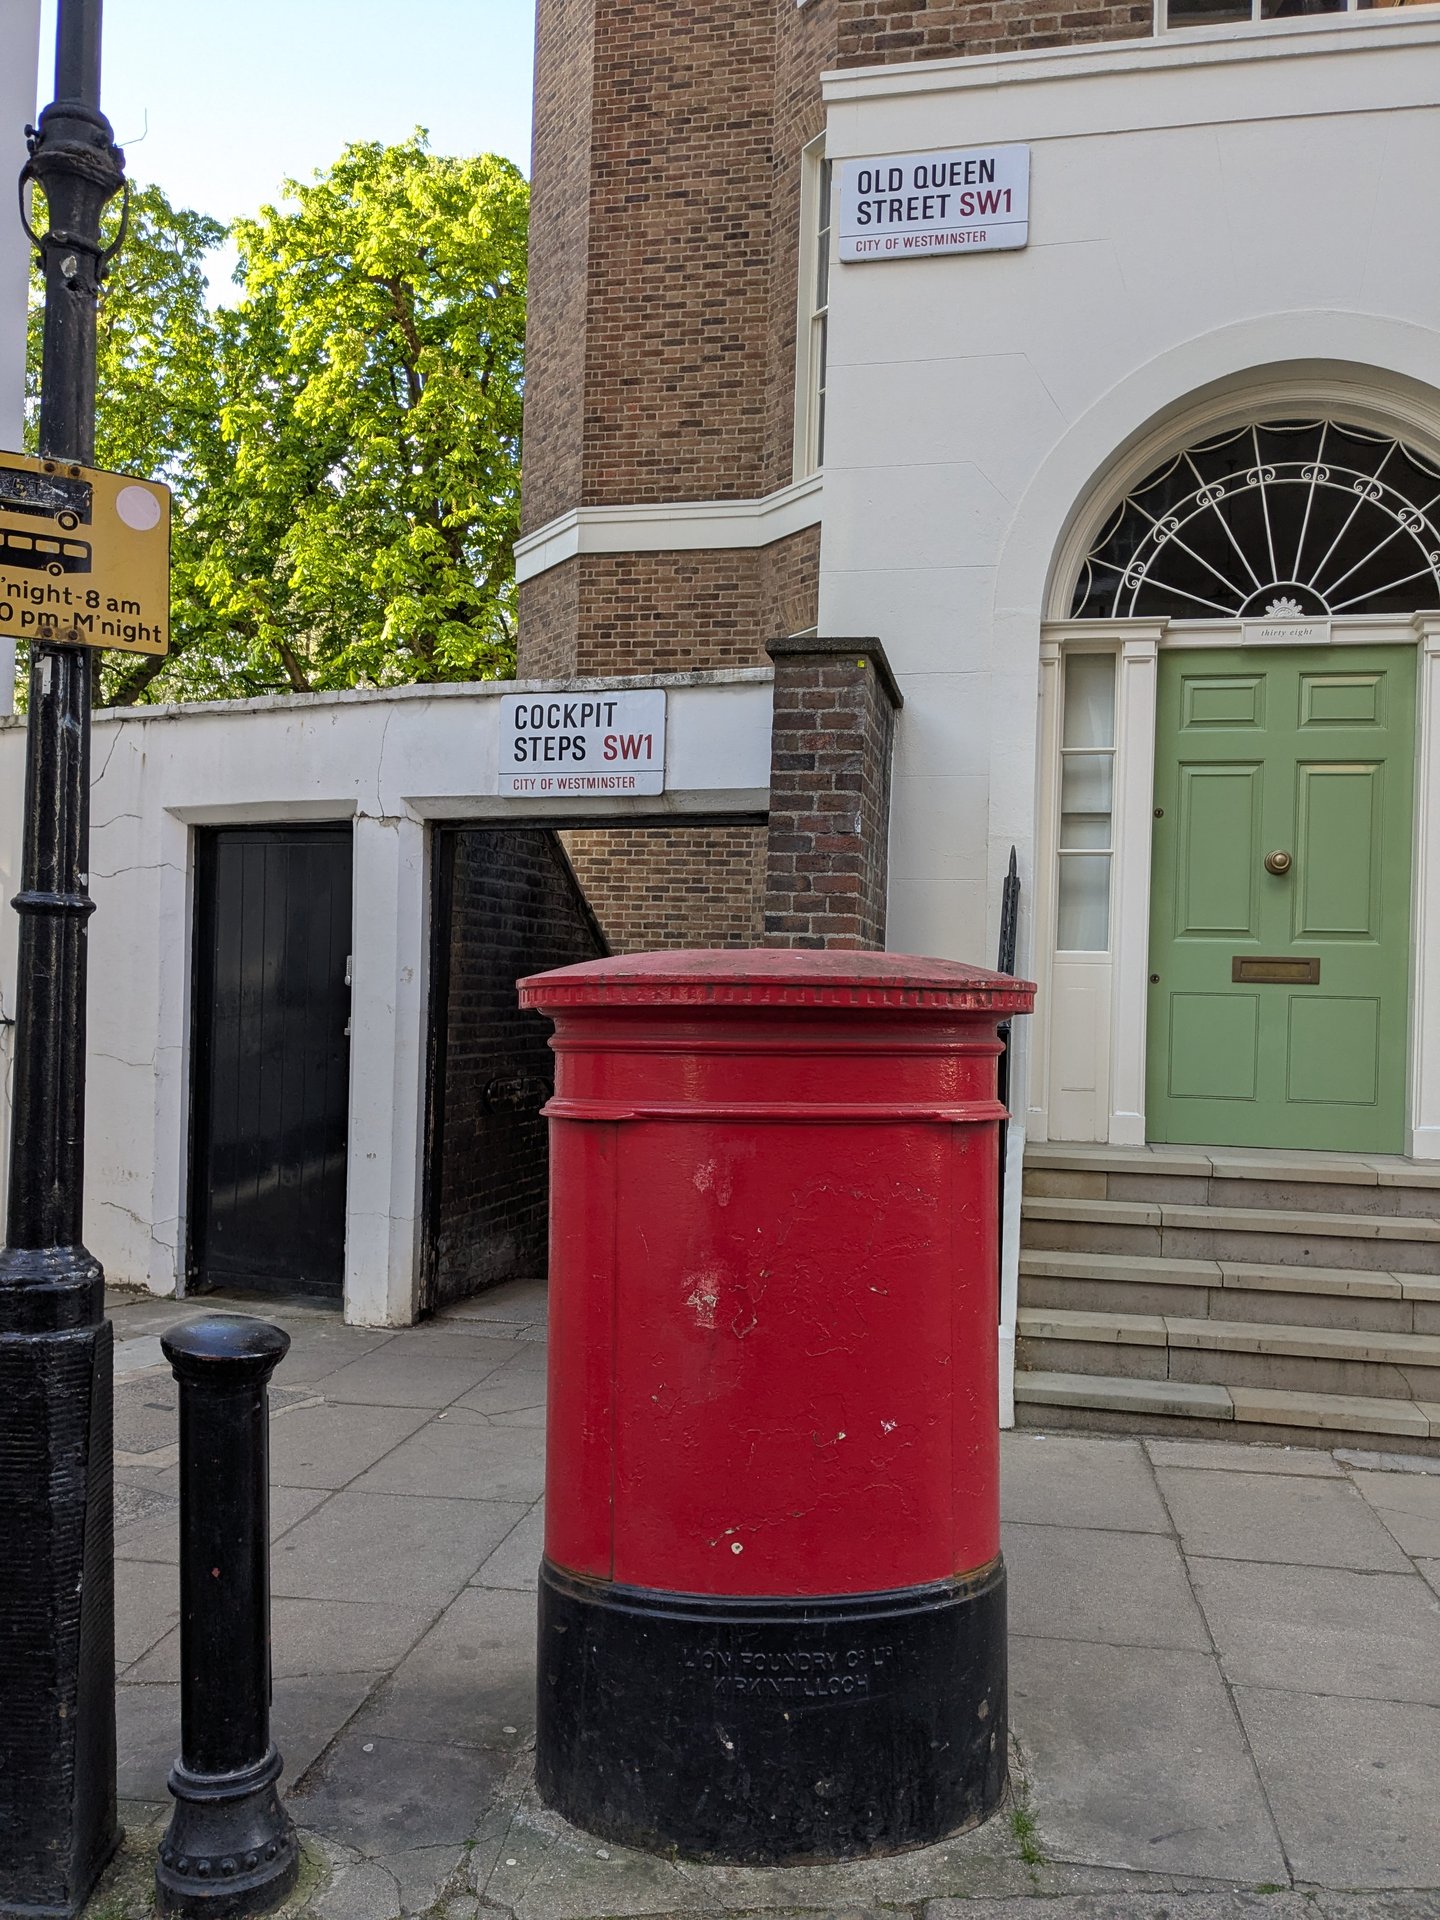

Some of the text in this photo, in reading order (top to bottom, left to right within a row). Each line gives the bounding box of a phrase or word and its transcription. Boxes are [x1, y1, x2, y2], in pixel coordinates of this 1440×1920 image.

[857, 158, 995, 195] OLD QUEEN
[856, 188, 1012, 226] STREET SW1
[856, 230, 986, 252] CITY OF WESTMINSTER
[0, 576, 141, 615] 'night-8 am
[1260, 628, 1313, 637] thirty eight
[514, 702, 618, 730] COCKPIT
[513, 734, 653, 762] STEPS SW1
[513, 776, 636, 790] CITY OF WESTMINSTER
[740, 1651, 837, 1671] FOUNDRY
